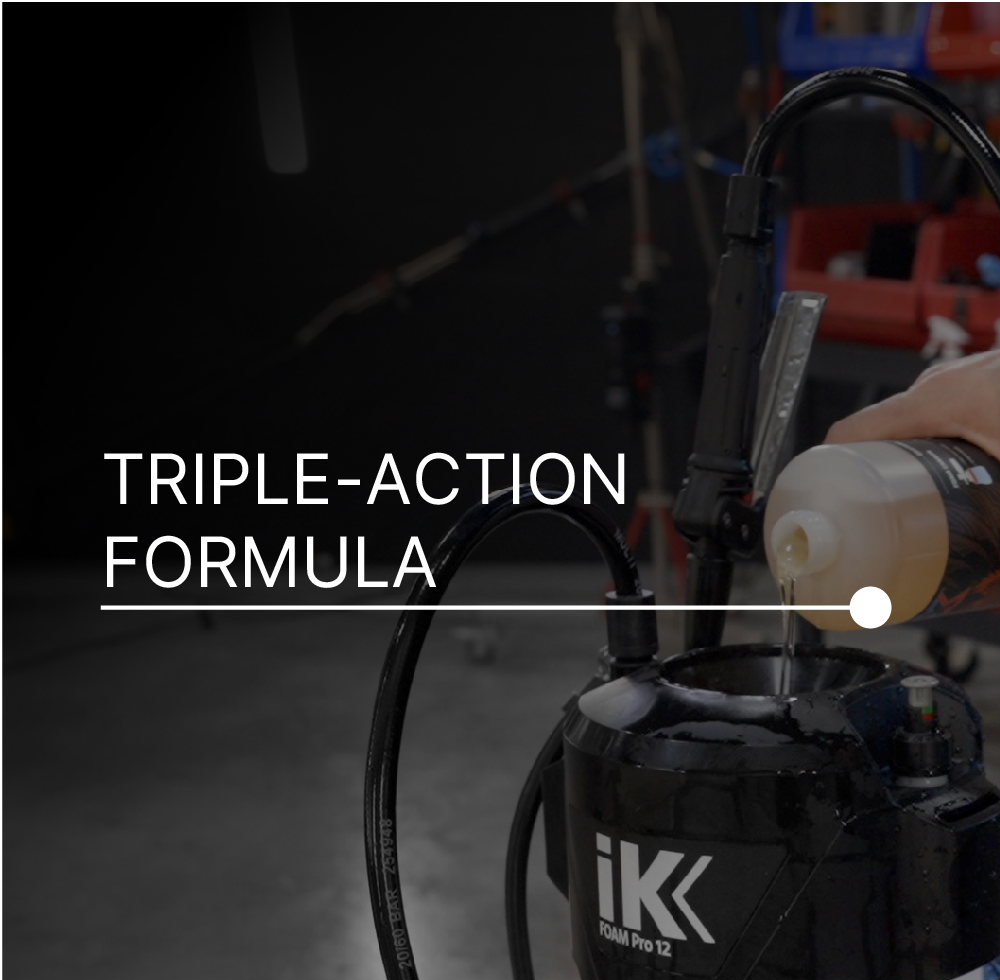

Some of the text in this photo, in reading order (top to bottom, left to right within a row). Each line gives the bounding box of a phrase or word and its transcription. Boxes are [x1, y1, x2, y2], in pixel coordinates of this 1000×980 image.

[386, 888, 402, 923] BAR
[393, 928, 413, 969] 20/60
[600, 920, 672, 957] FOAM Pro 12
